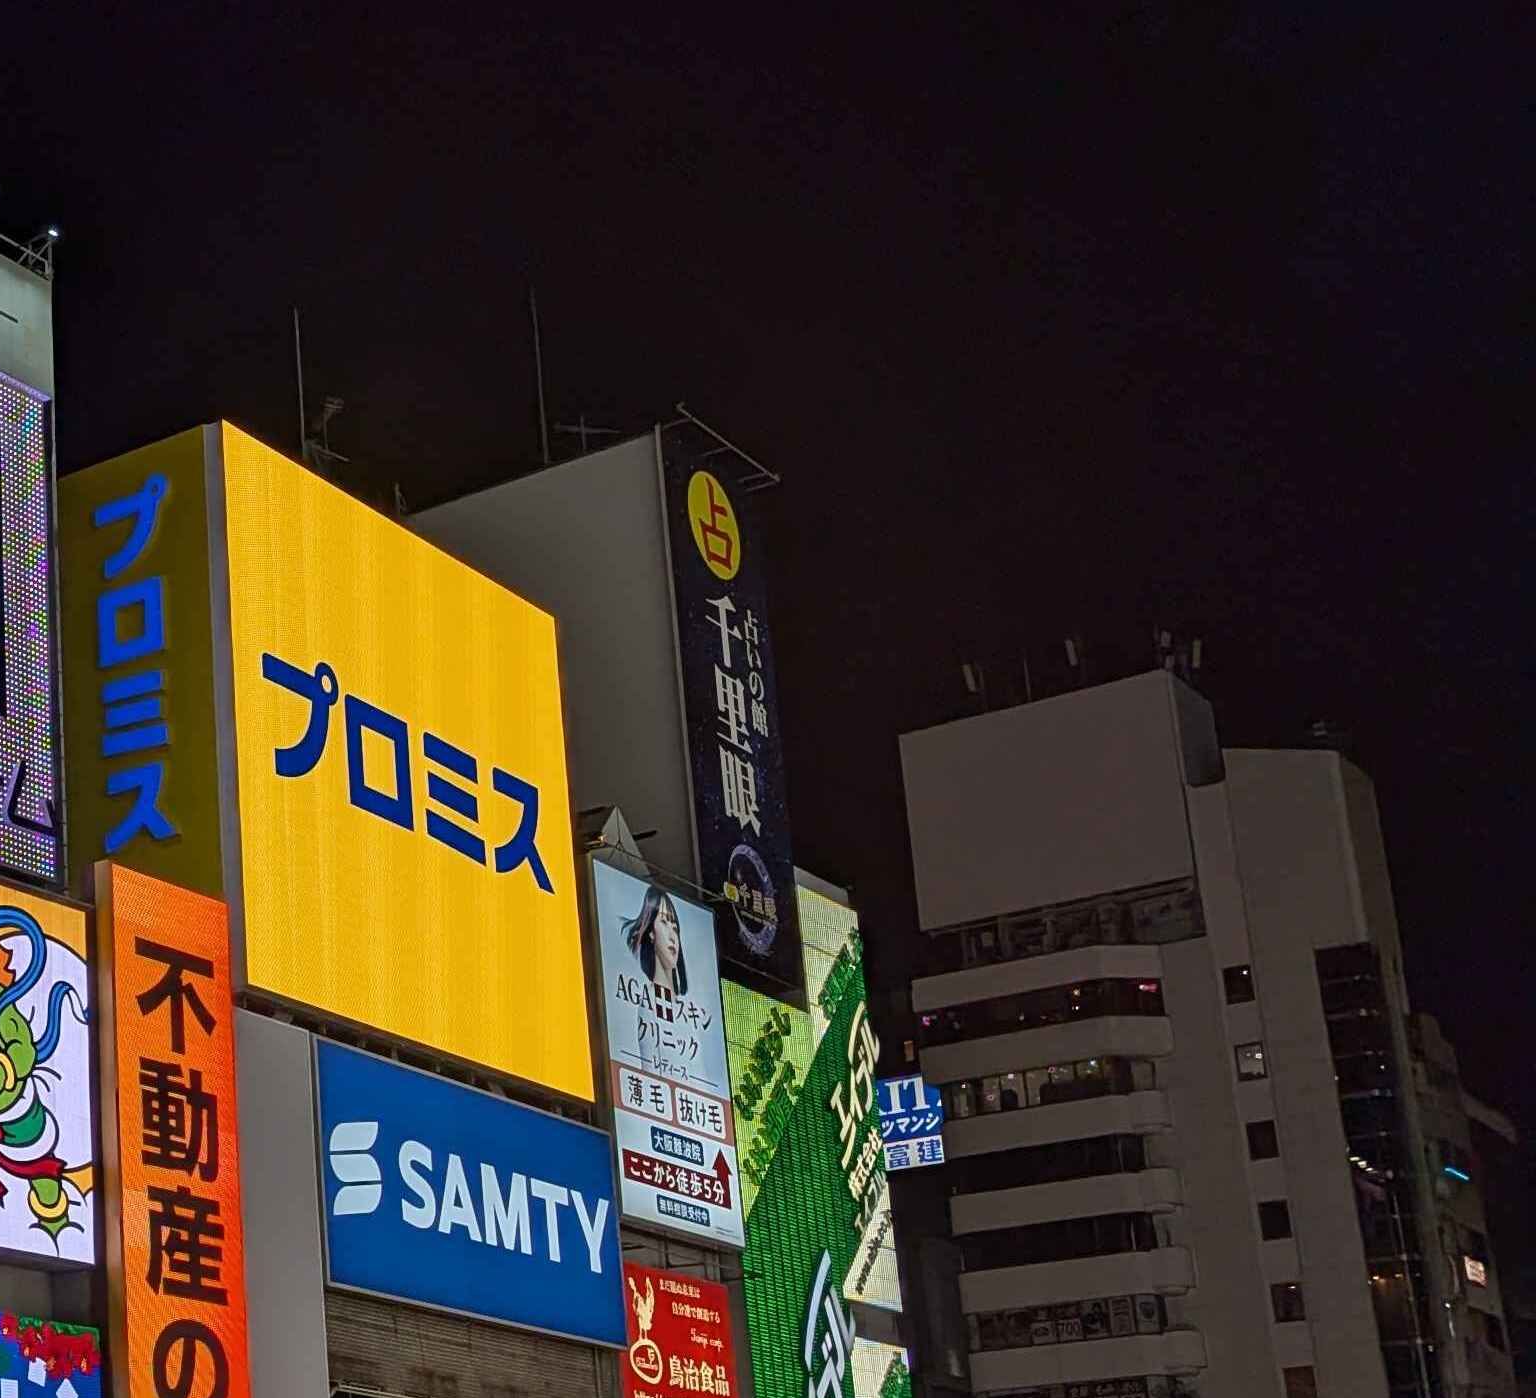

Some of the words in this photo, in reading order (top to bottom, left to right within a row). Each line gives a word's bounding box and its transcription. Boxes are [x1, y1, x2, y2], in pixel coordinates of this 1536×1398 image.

[701, 478, 732, 572] 占
[92, 472, 180, 856] プロミス
[706, 596, 761, 839] 千里眼
[262, 652, 555, 895] プロミス
[616, 973, 654, 1011] AGA
[675, 1001, 713, 1031] スキン
[637, 1016, 700, 1061] クリニック
[627, 1074, 665, 1115] 薄毛
[679, 1092, 723, 1134] 抜け毛
[398, 1139, 610, 1275] SAMTY
[629, 1156, 724, 1206] ここから徒歩5分
